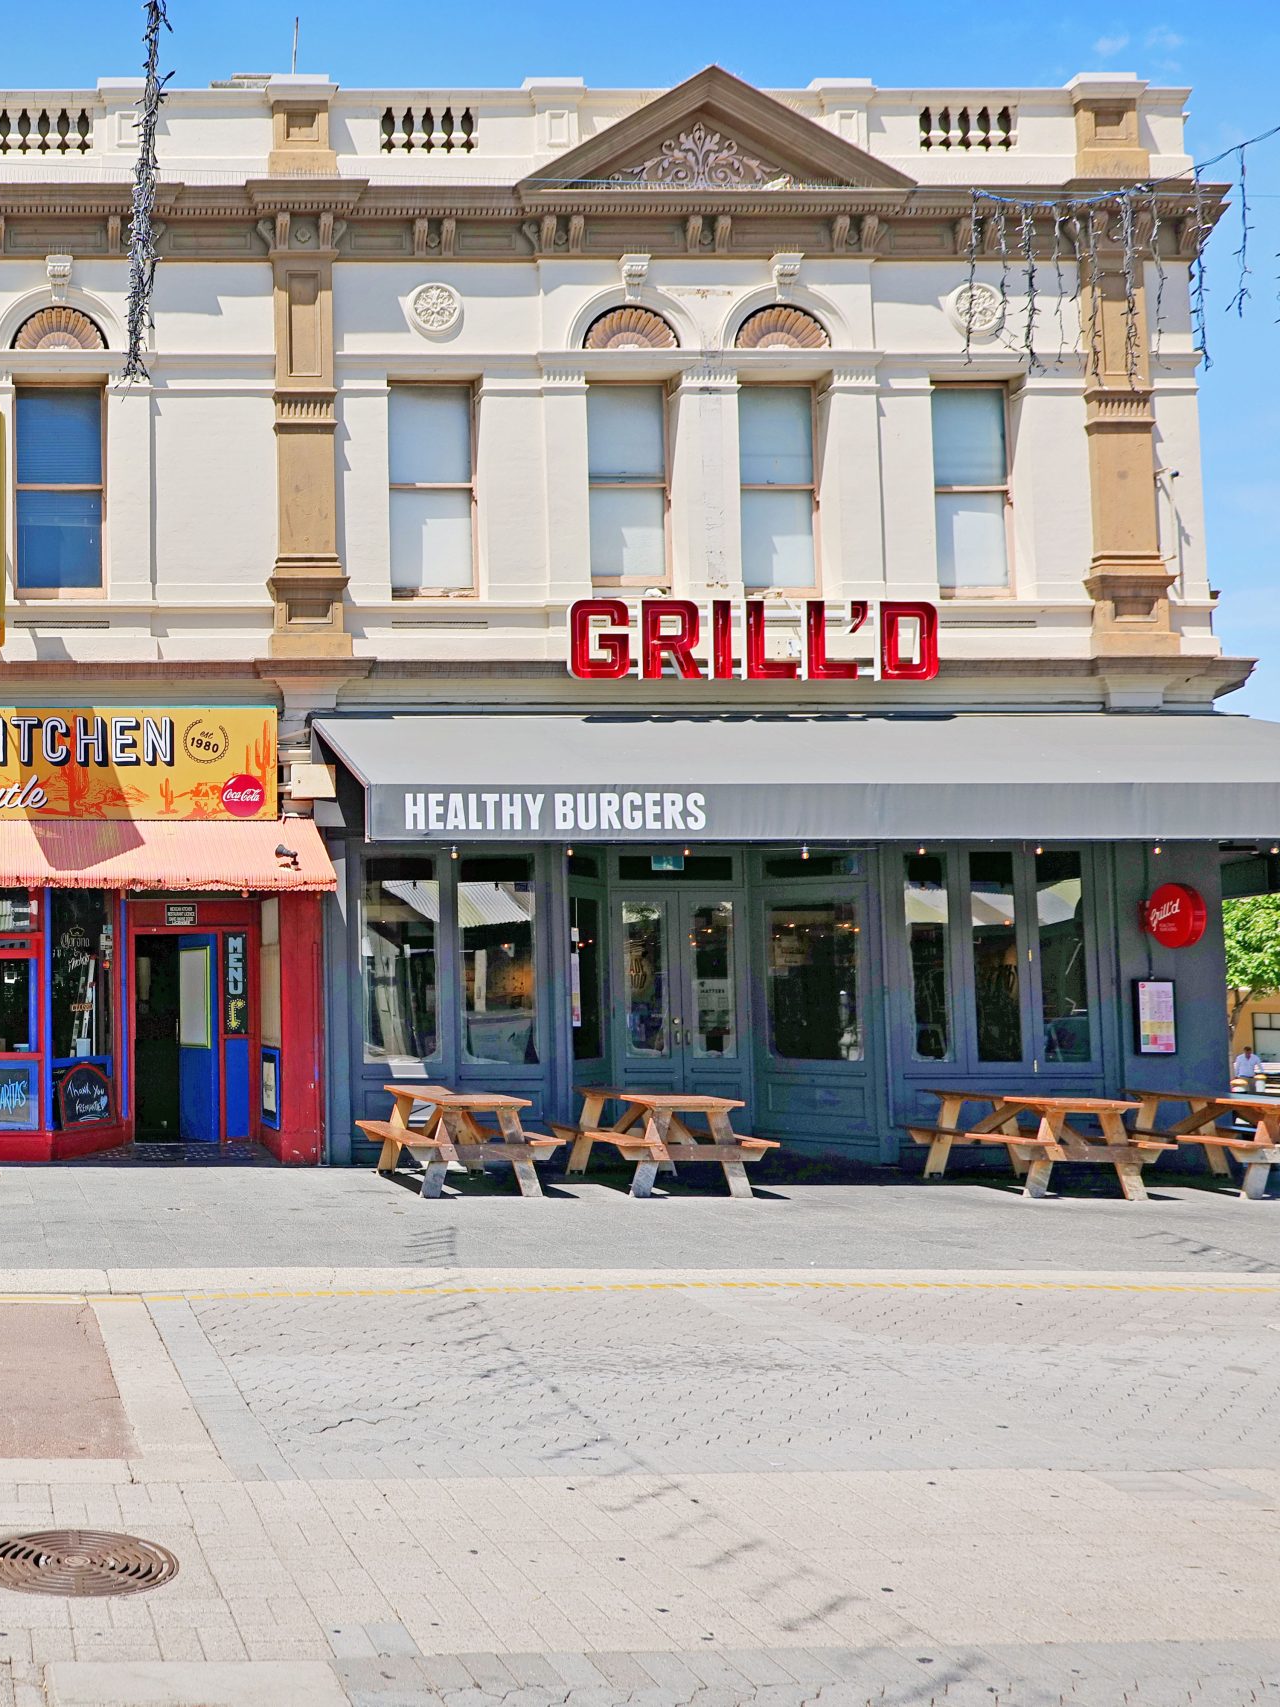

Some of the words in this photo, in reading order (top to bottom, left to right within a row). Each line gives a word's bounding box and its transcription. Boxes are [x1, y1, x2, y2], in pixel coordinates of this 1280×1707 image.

[566, 599, 940, 681] GRILL'D
[190, 736, 220, 754] 1980
[404, 792, 545, 831] HEALTHY
[553, 790, 707, 831] BURGERS
[1149, 897, 1181, 932] Grill'd
[60, 932, 90, 950] Corona
[228, 936, 244, 995] MENU
[66, 1079, 92, 1098] Thank
